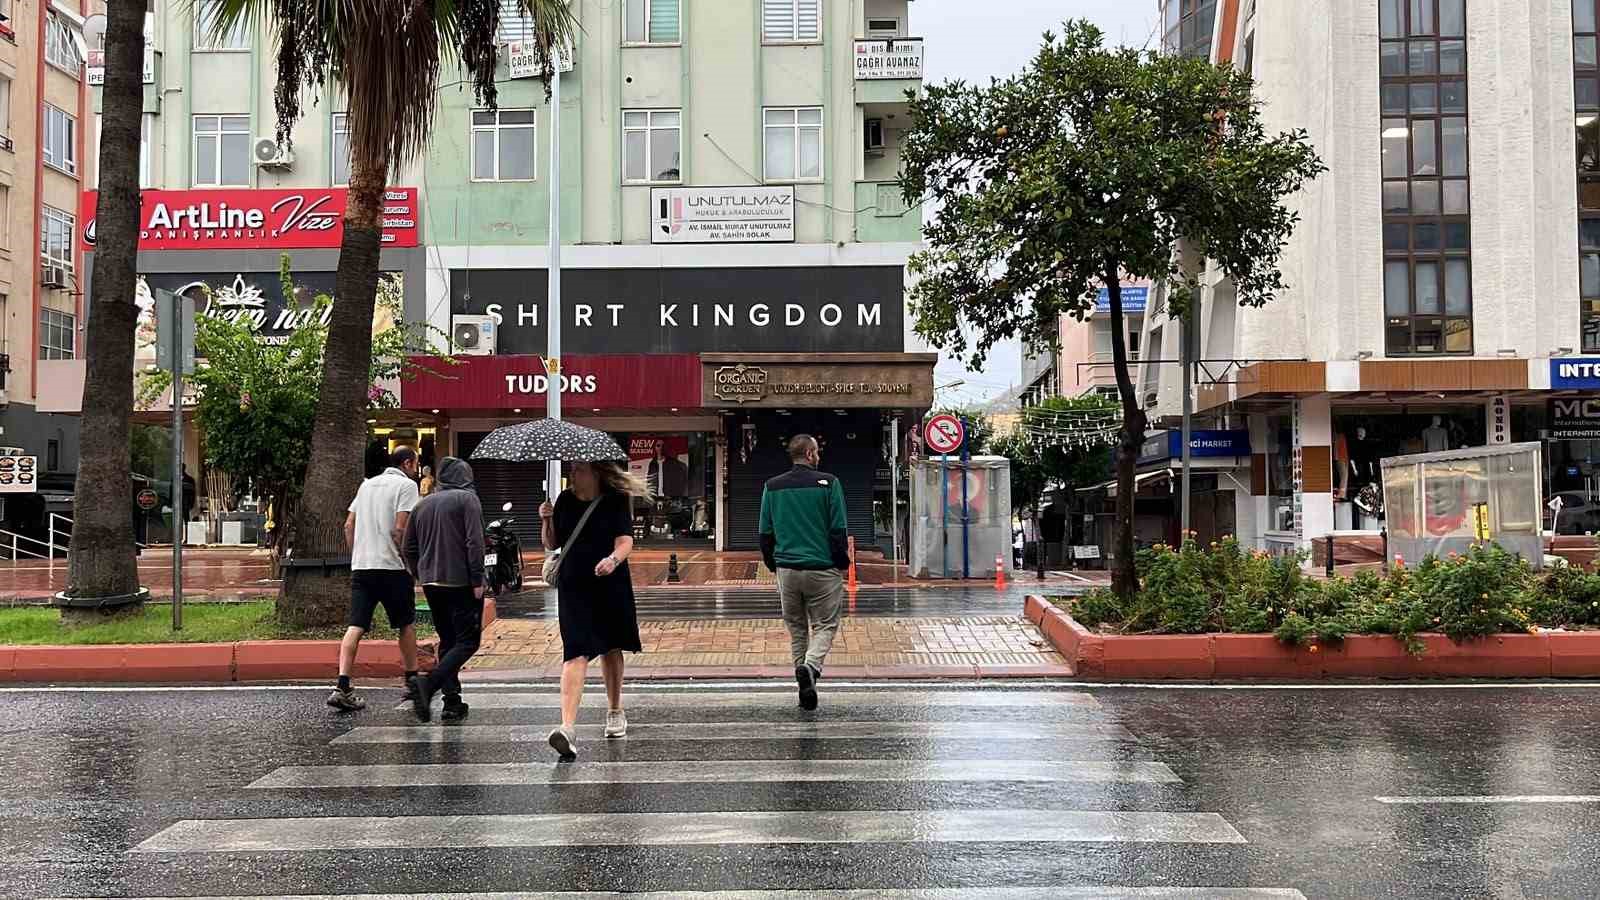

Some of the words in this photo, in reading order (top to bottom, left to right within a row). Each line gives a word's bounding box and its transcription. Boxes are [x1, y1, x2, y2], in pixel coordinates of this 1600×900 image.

[688, 195, 791, 206] UNUTULMAZ
[148, 202, 264, 229] ArtLine
[271, 195, 339, 232] Vize
[141, 230, 280, 240] DANIŞMANLIK
[272, 296, 335, 330] nal
[486, 303, 625, 327] SHRT
[659, 303, 882, 328] KINGDOM
[1560, 363, 1600, 377] INTE
[719, 373, 764, 385] ORGANIC
[771, 383, 799, 394] URKISH
[722, 384, 761, 393] GARDEN
[631, 439, 654, 448] NEW
